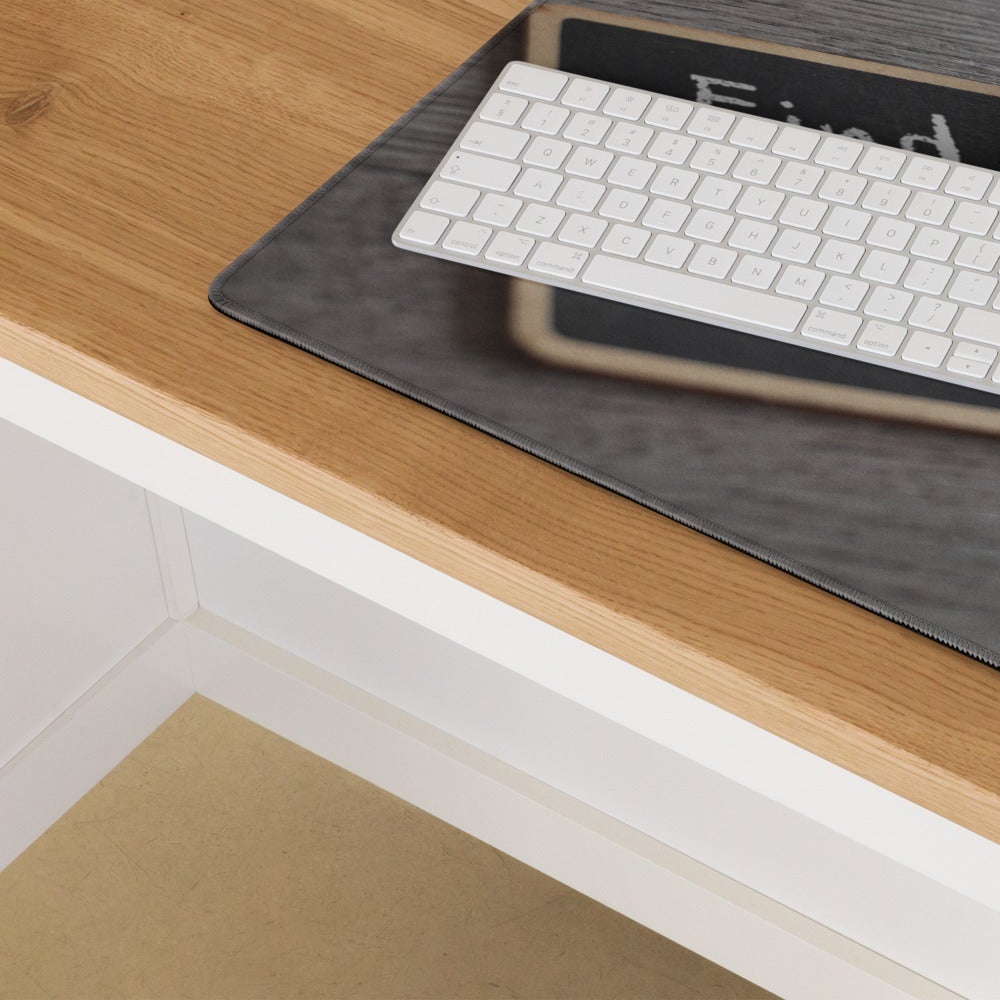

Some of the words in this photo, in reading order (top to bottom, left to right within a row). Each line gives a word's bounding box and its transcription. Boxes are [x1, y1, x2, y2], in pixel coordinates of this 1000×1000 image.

[543, 148, 553, 157] Q
[585, 158, 597, 166] W
[627, 168, 637, 176] E
[670, 178, 679, 186] R
[758, 198, 766, 206] Y
[799, 208, 809, 217] U
[886, 229, 896, 237] O
[581, 129, 590, 137] 2
[622, 138, 631, 146] 3
[707, 158, 715, 166] 5
[750, 168, 758, 176] 6
[793, 178, 802, 186] 7
[836, 188, 845, 196] 8
[535, 216, 546, 224] Z
[578, 225, 588, 234] X
[621, 236, 631, 244] C
[666, 247, 675, 255] V
[708, 257, 717, 265] B
[752, 268, 762, 276] N
[795, 277, 807, 286] M
[618, 201, 629, 209] D
[662, 210, 671, 218] F
[705, 221, 715, 230] G
[748, 231, 759, 240] H
[792, 242, 801, 250] J
[836, 252, 844, 260] K
[450, 238, 479, 249] control
[494, 250, 520, 260] option
[536, 260, 575, 273] command
[807, 326, 847, 339] command
[863, 339, 889, 350] option
